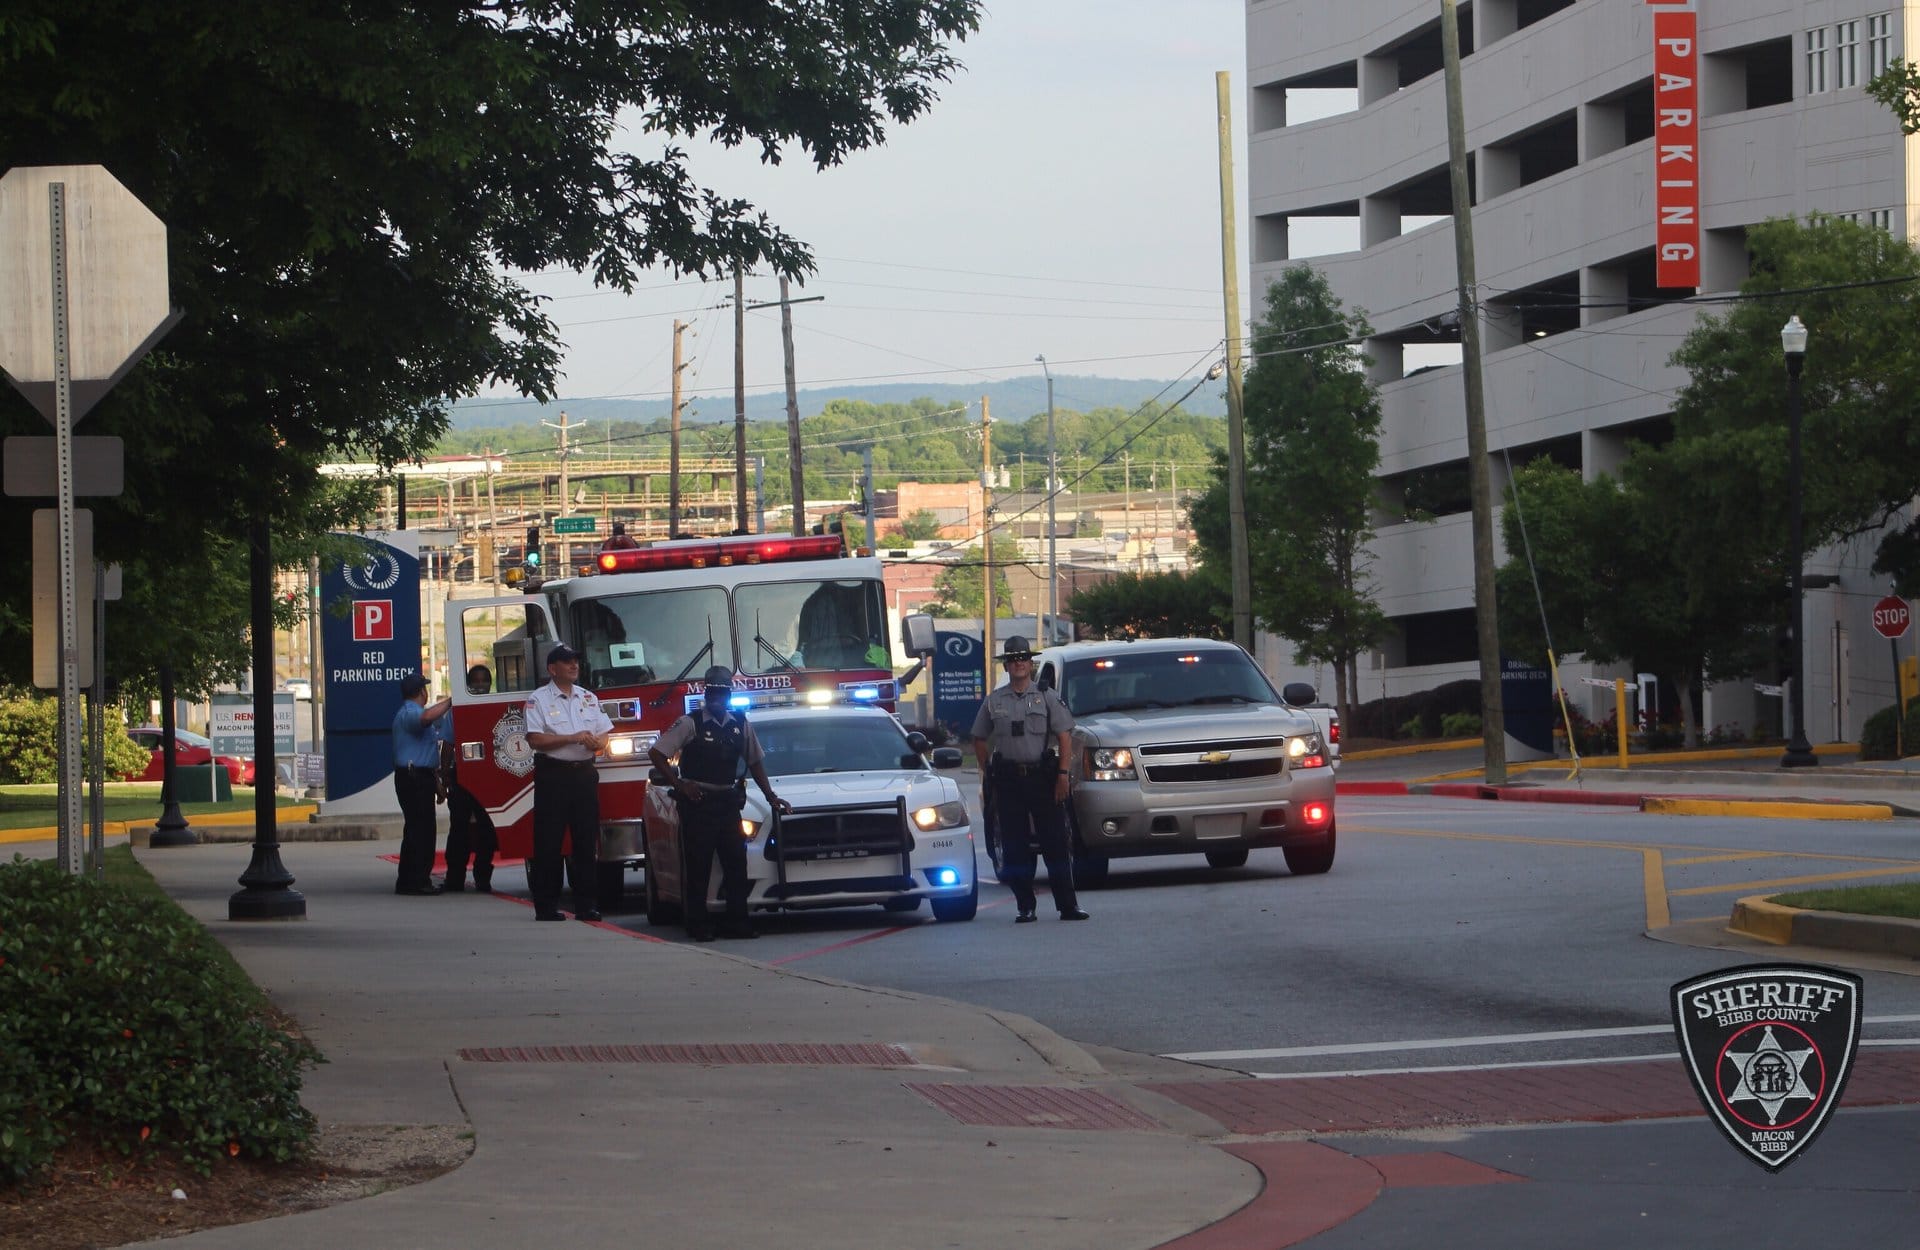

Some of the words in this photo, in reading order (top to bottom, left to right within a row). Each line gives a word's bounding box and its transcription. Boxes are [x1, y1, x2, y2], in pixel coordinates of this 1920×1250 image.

[1659, 38, 1694, 263] PARKING
[558, 521, 578, 530] First
[582, 520, 592, 529] St
[365, 605, 383, 636] P
[1875, 608, 1908, 625] STOP
[363, 651, 385, 665] RED
[333, 667, 382, 682] PARKING
[1501, 671, 1528, 680] ARKING
[234, 713, 254, 721] REN
[514, 740, 522, 752] 1
